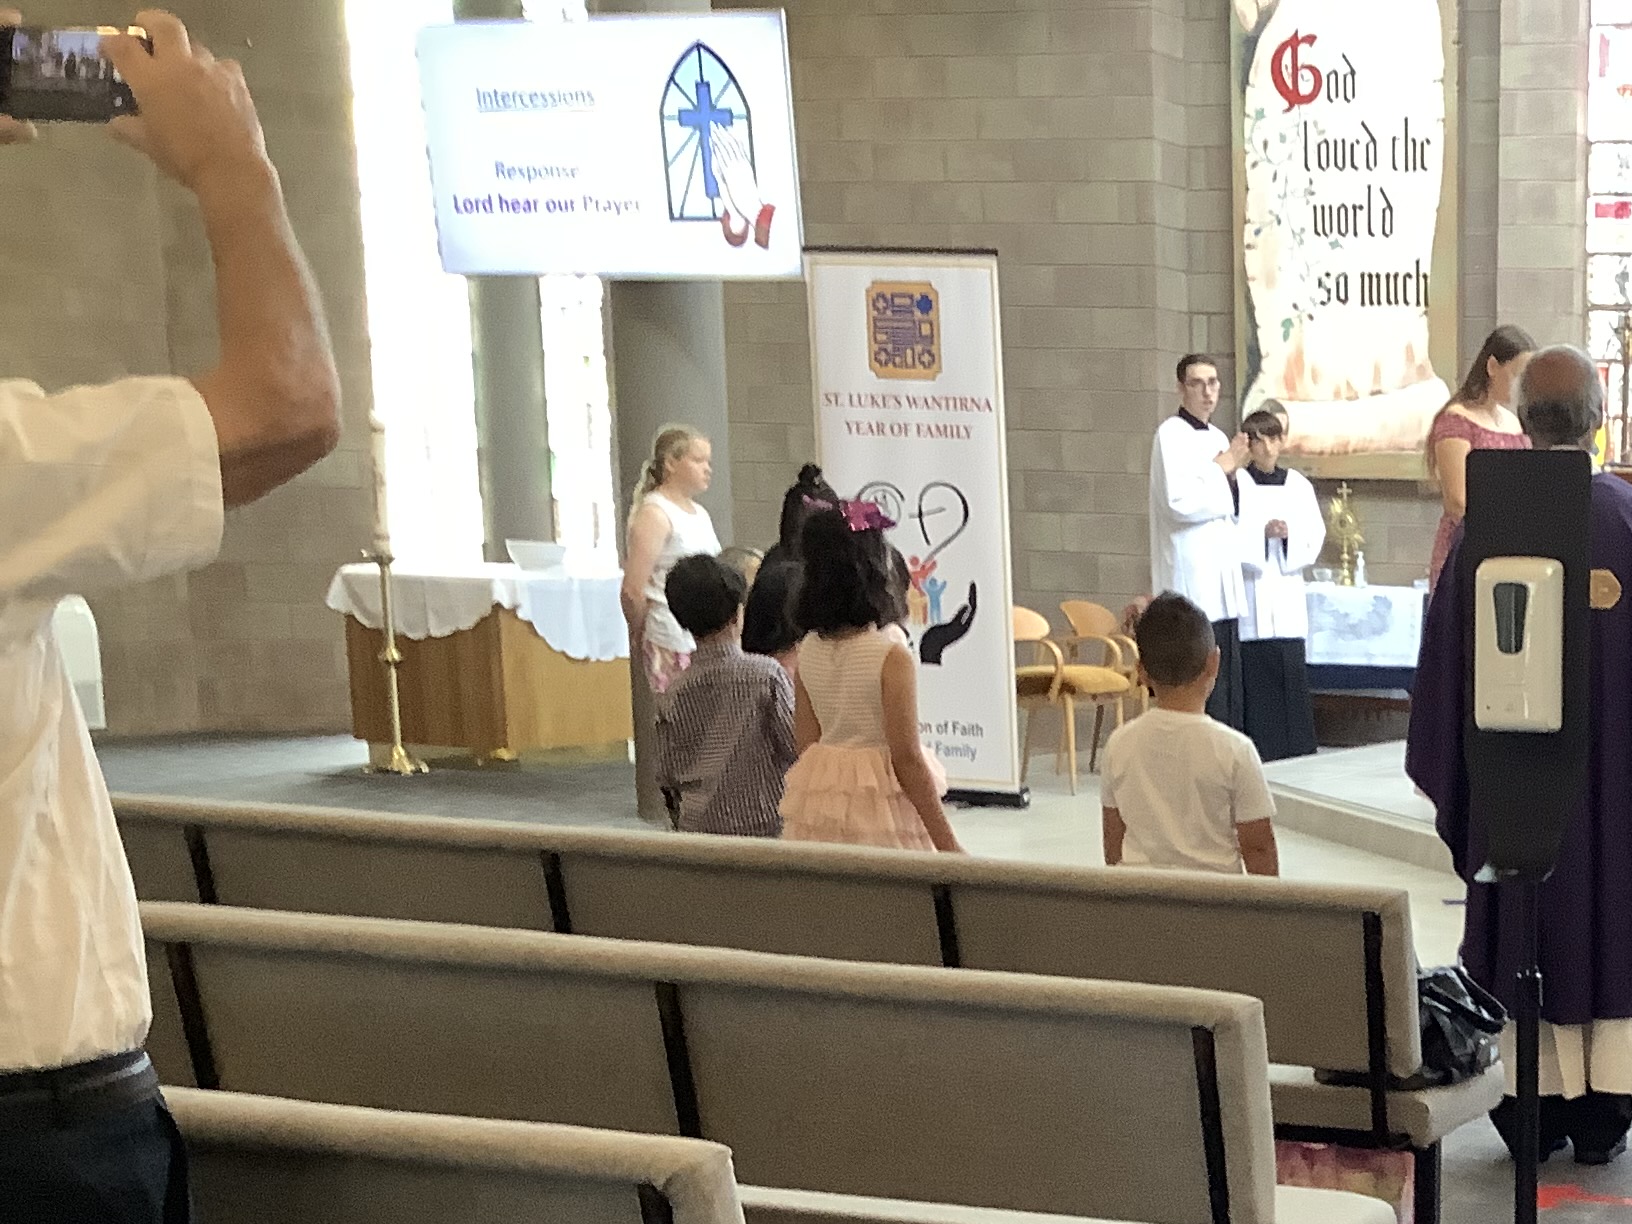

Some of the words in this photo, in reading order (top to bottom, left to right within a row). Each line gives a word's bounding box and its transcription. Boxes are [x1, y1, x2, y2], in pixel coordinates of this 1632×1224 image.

[1270, 28, 1357, 114] God
[476, 87, 595, 110] Intercessions
[1303, 120, 1378, 172] loved
[1391, 116, 1432, 173] the
[453, 194, 494, 214] Lord
[498, 193, 539, 214] hear
[546, 199, 576, 214] our
[583, 194, 640, 216] Prayer
[1312, 184, 1394, 238] world
[1317, 271, 1350, 306] so
[1359, 258, 1430, 308] much
[906, 396, 993, 412] WANTIRNA
[845, 421, 886, 436] YEAR
[889, 422, 910, 437] OF
[916, 423, 973, 440] FAMILY
[936, 721, 949, 735] of
[951, 720, 984, 738] Faith
[935, 741, 977, 762] Family
